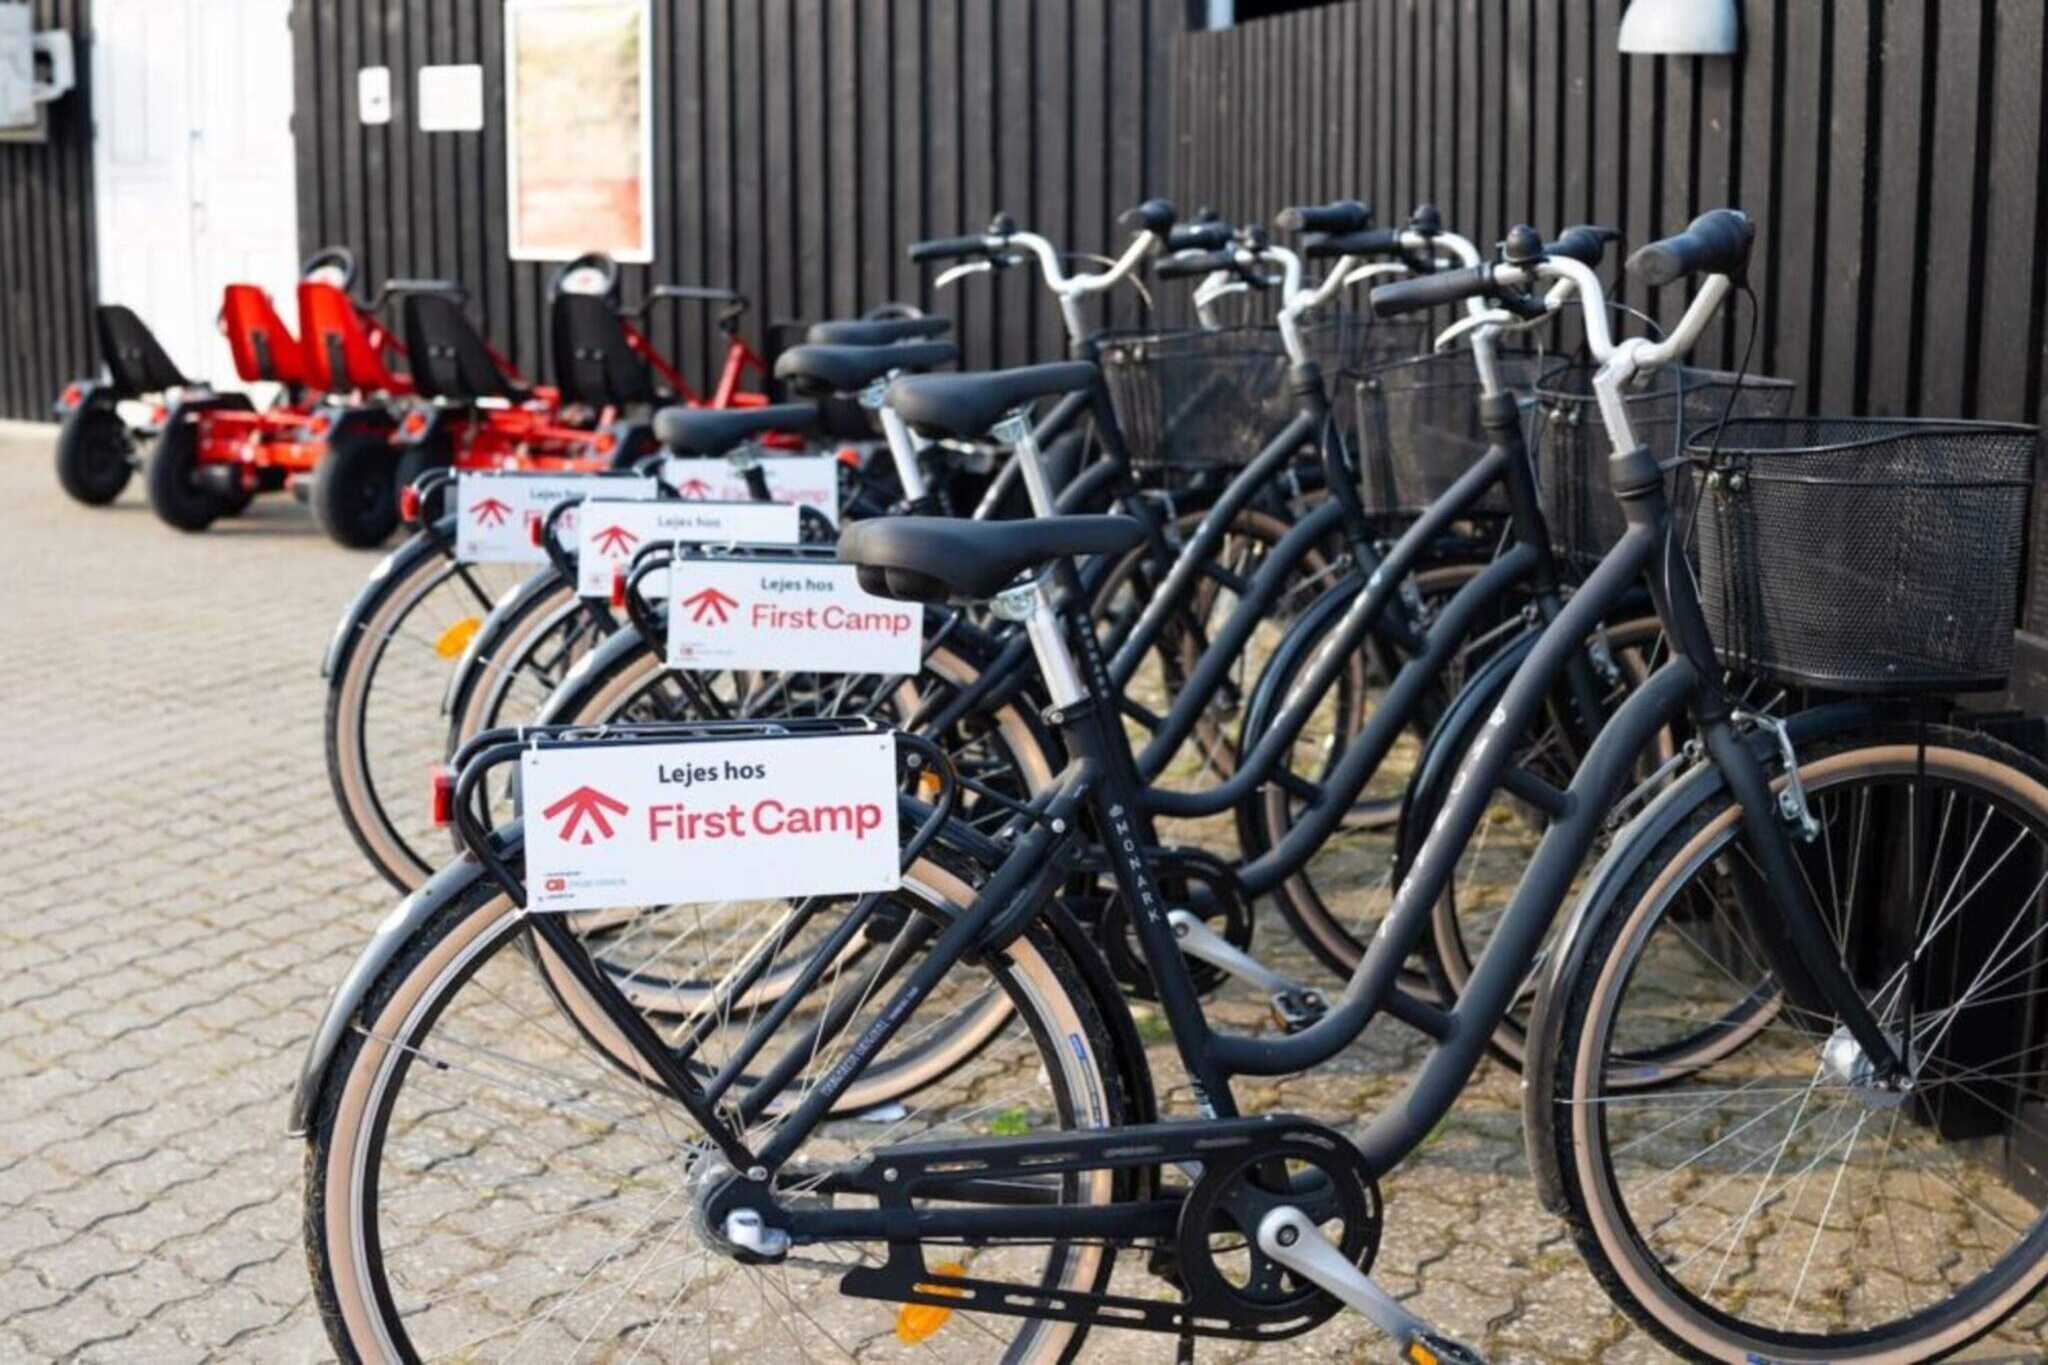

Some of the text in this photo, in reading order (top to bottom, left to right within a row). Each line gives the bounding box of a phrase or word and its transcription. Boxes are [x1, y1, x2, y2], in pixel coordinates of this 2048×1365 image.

[760, 577, 834, 593] Lejes hos
[751, 603, 912, 637] First Camp
[658, 760, 766, 788] Lejes hos
[649, 799, 882, 842] First Camp
[1115, 821, 1161, 925] MONARK
